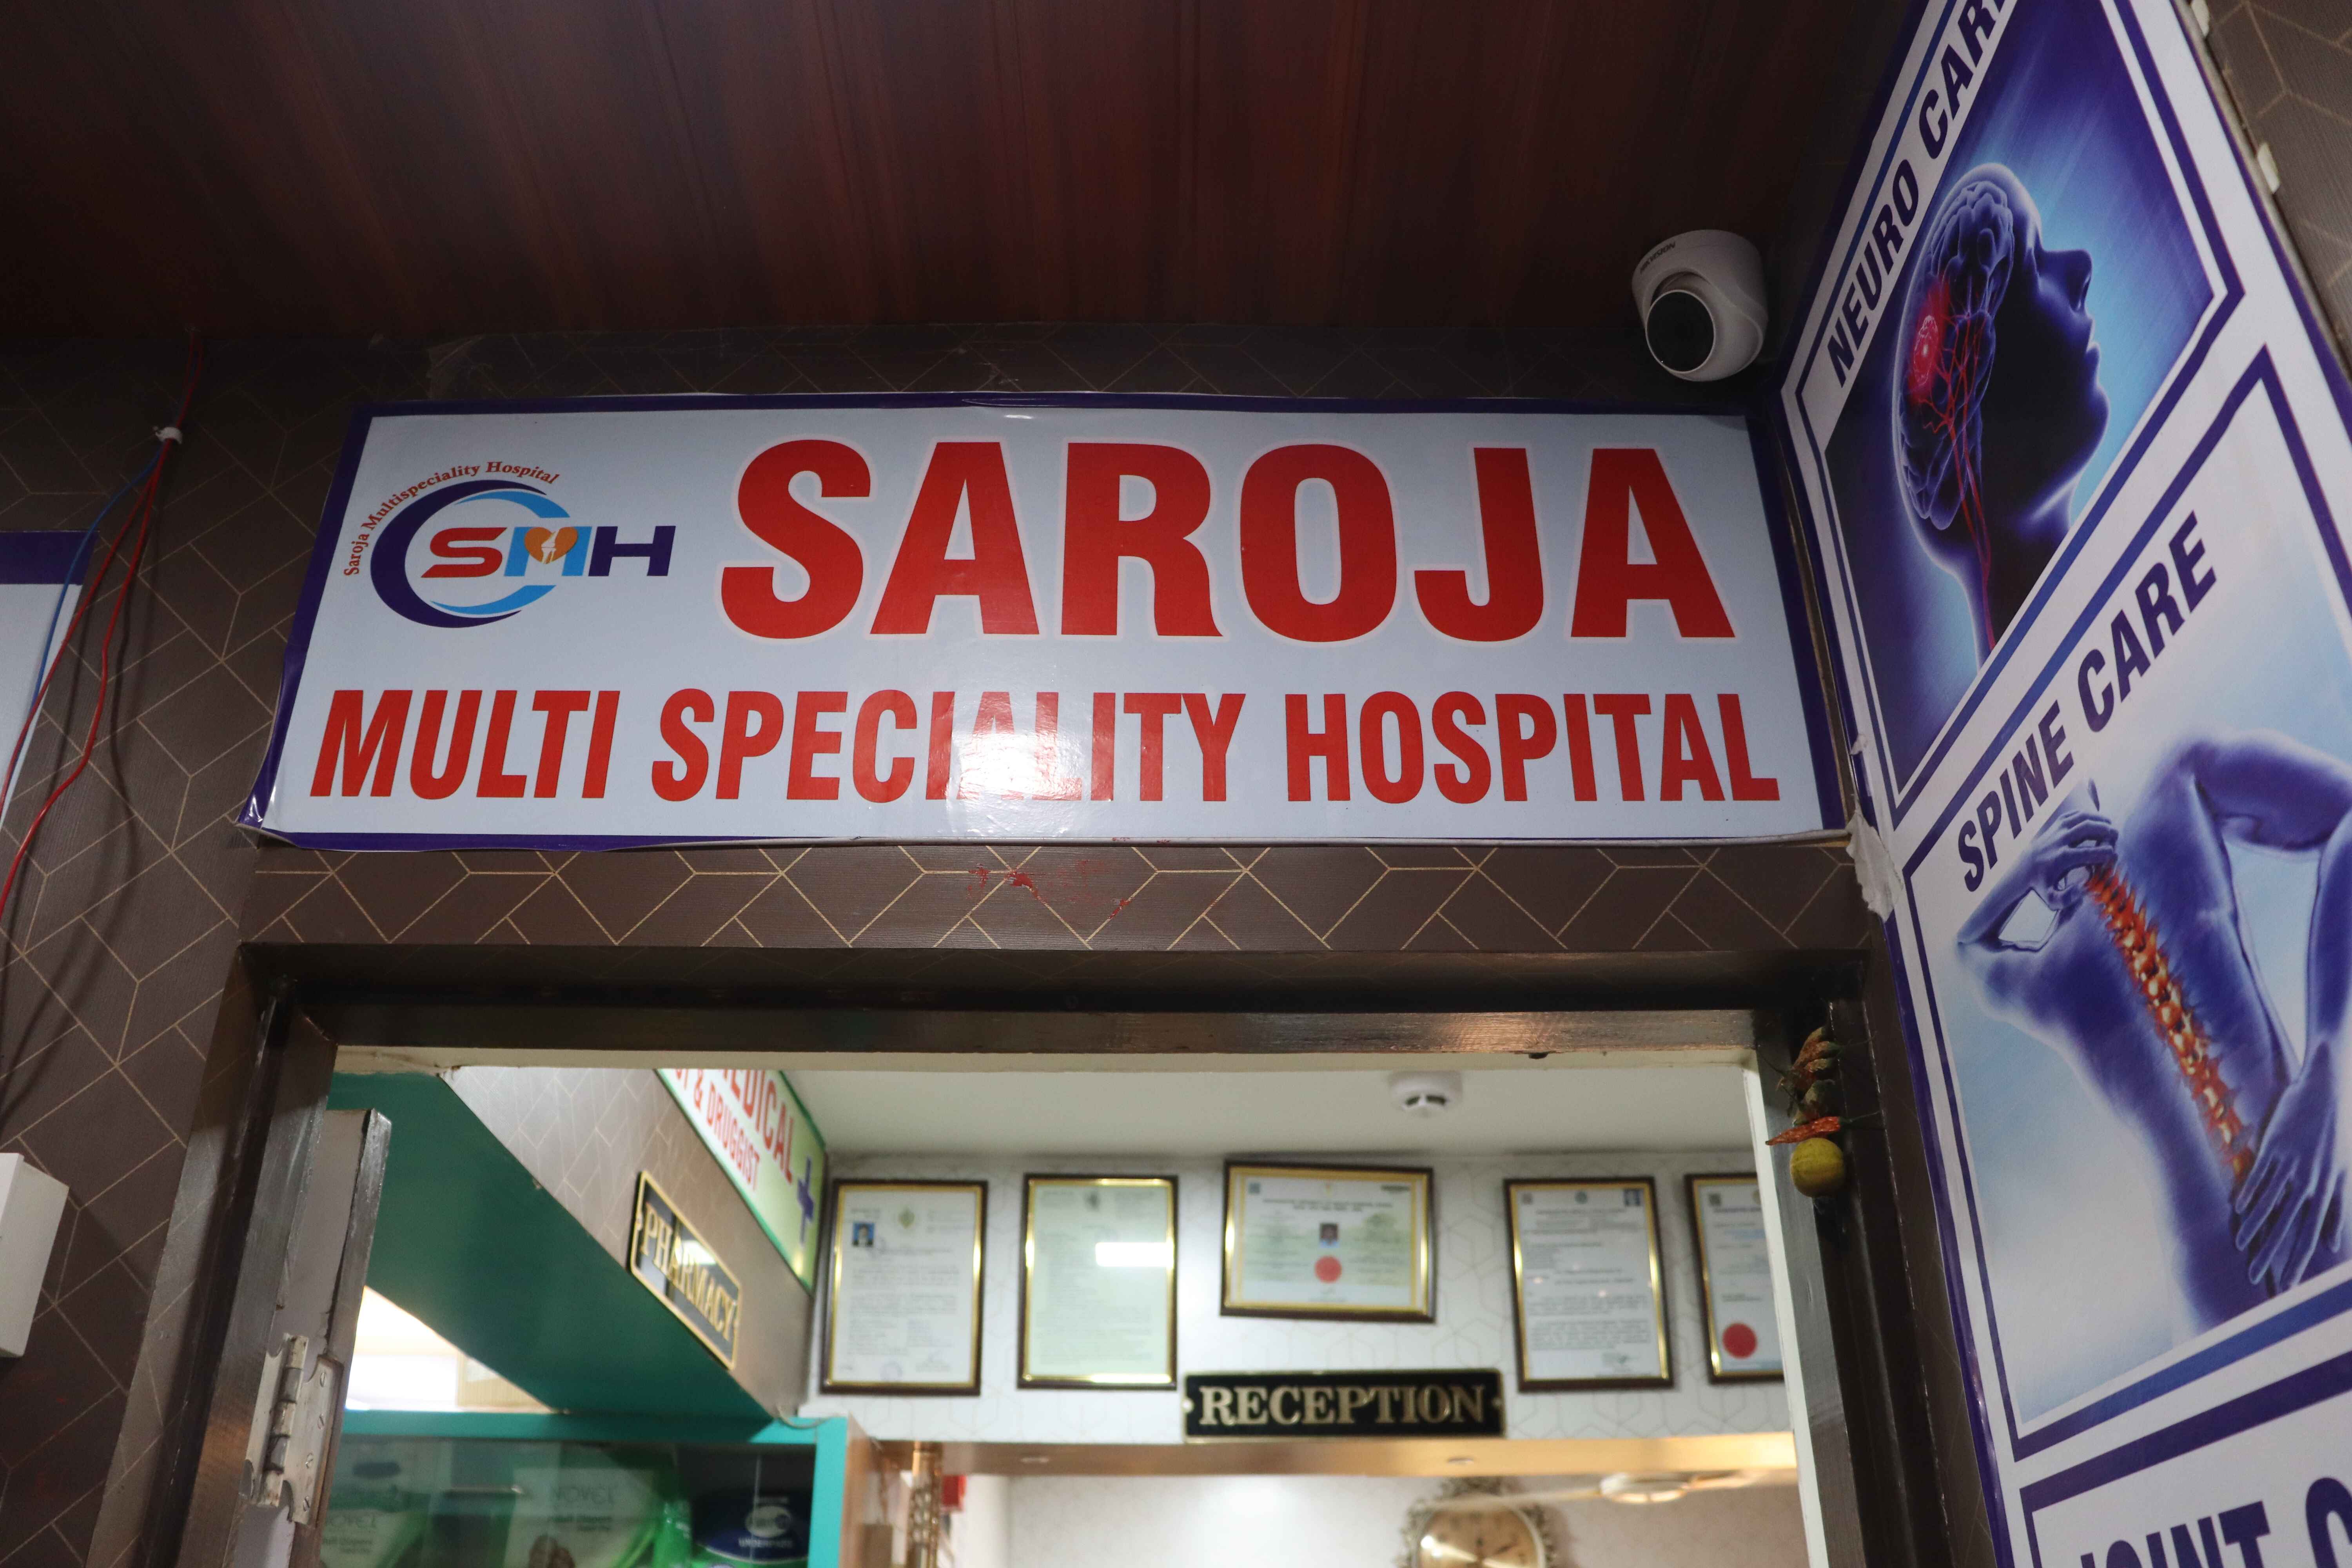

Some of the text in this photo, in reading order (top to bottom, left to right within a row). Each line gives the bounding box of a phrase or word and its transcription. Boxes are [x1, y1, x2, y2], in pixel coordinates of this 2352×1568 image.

[1827, 0, 2006, 387] NEURO CAR
[343, 461, 560, 576] Saroja Multispeciality Hospital
[421, 526, 676, 578] SMH
[722, 439, 1734, 642] SAROJA
[311, 688, 1779, 804] MULTI SPECIALITY HOSPITAL
[1958, 510, 2217, 892] SPINE CARE
[706, 1080, 760, 1191] DRUGGIST
[723, 1069, 794, 1185] DICAL
[640, 1201, 737, 1341] PHARMACY
[1198, 1385, 1485, 1426] RECEPTION
